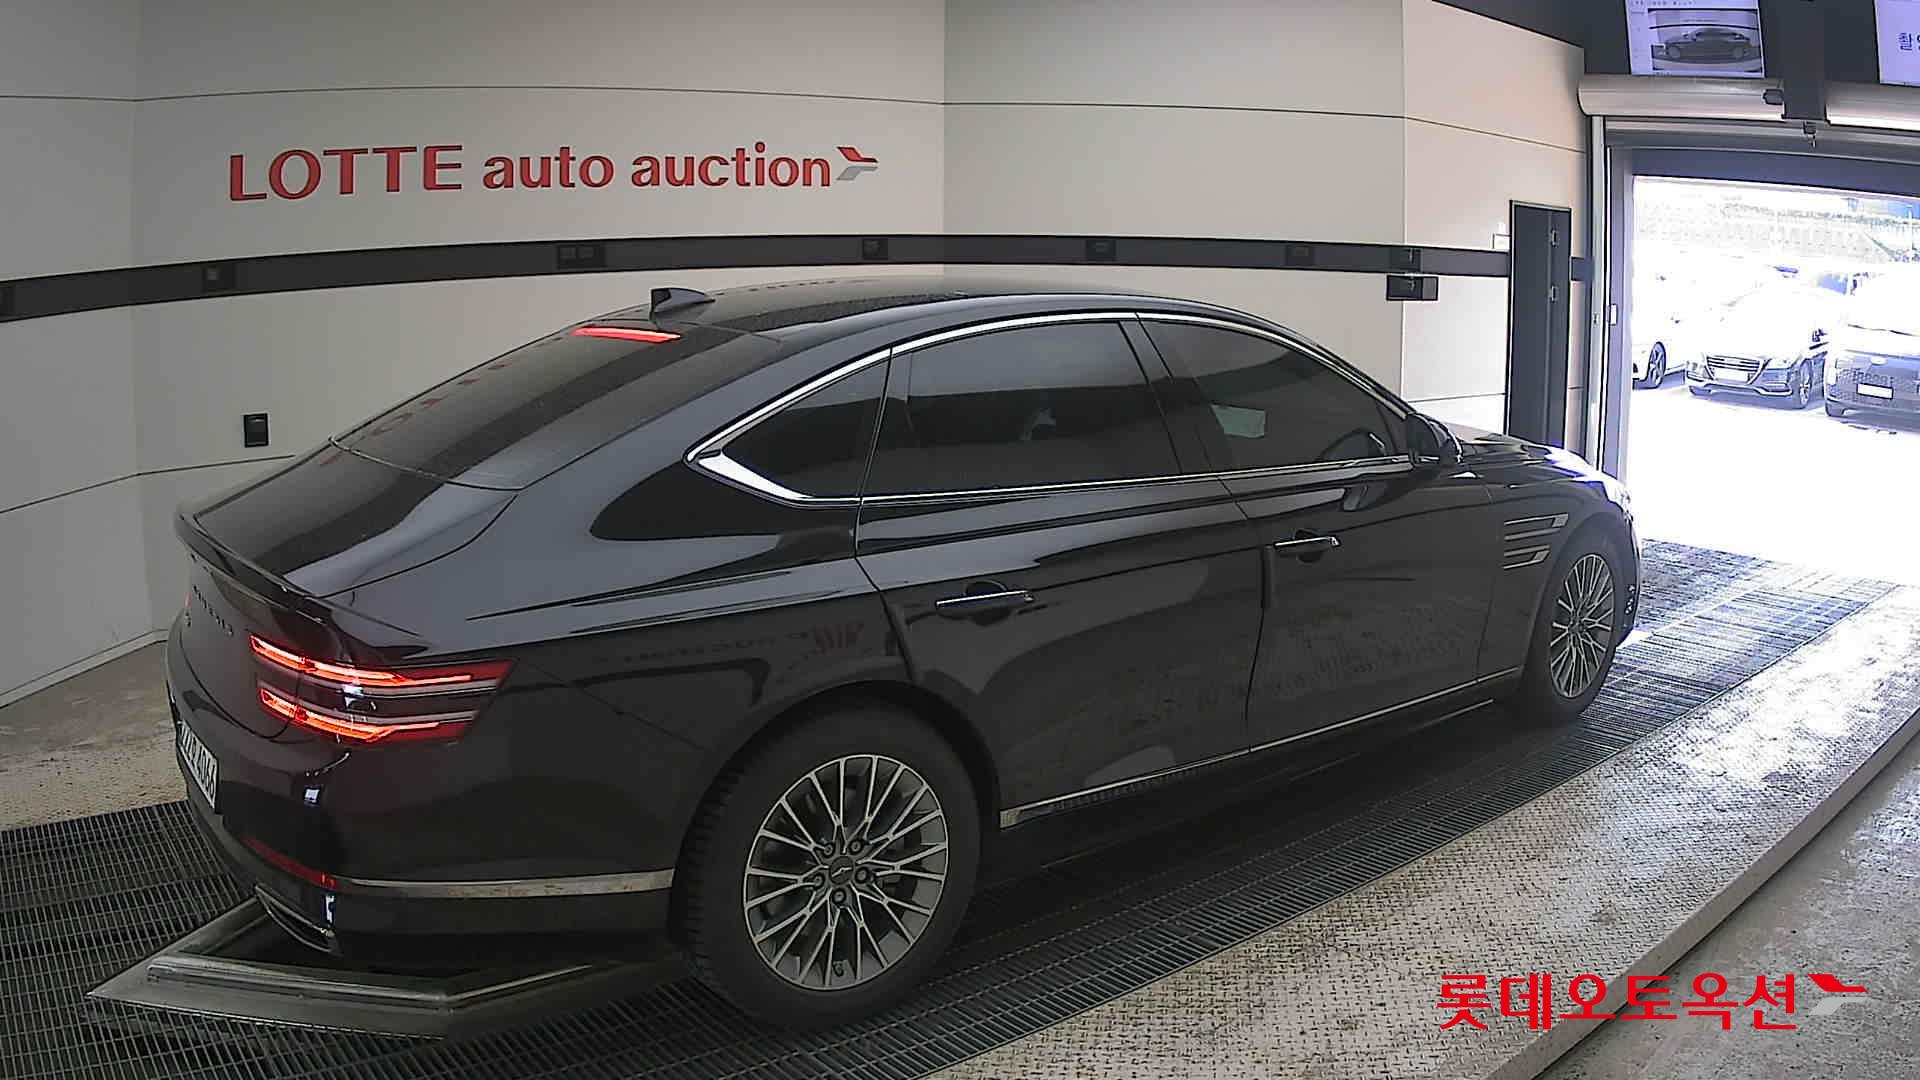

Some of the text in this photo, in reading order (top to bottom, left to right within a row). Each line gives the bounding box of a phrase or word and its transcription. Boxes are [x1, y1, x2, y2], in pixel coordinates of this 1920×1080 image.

[229, 142, 831, 201] LOTTE auto auction
